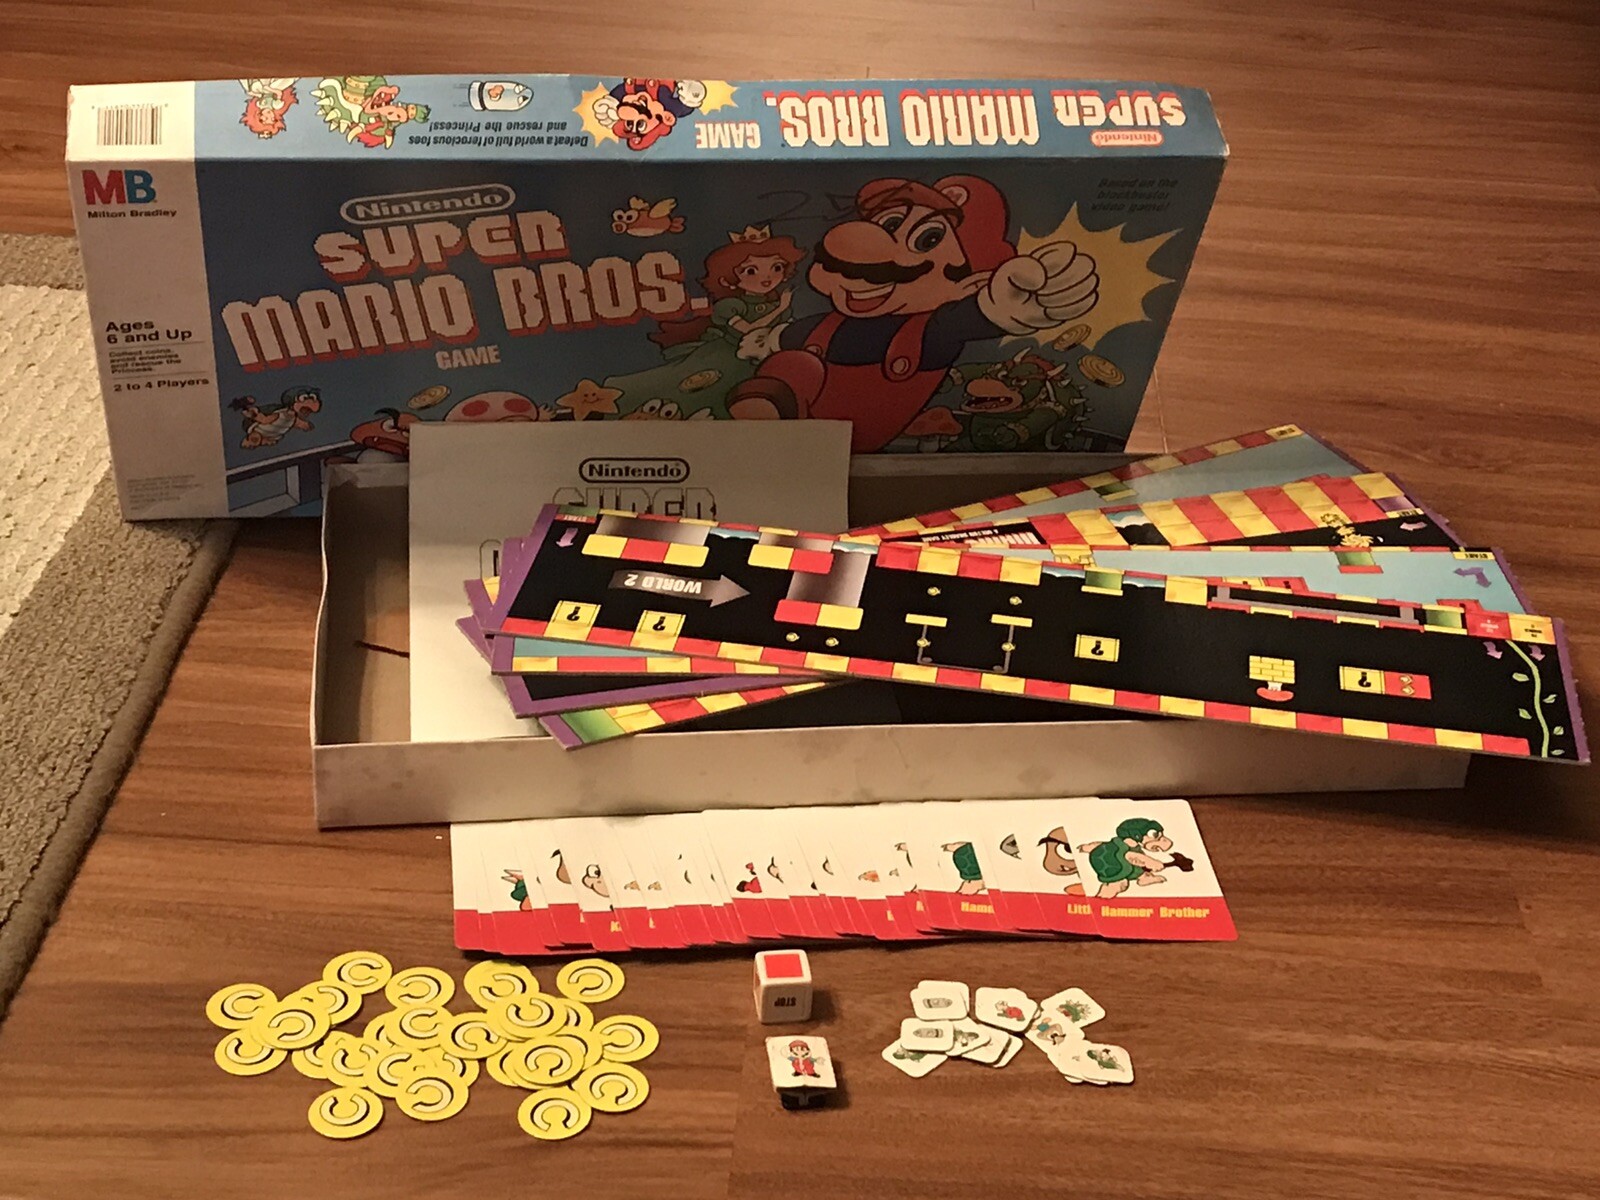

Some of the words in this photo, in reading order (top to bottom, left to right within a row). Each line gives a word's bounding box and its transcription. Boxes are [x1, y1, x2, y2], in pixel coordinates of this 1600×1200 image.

[1050, 89, 1186, 126] SUPER
[762, 89, 889, 147] BROS.
[899, 88, 1040, 146] MARIO
[429, 121, 480, 132] Princess!
[485, 121, 502, 132] the
[506, 121, 543, 132] rescue
[546, 121, 567, 132] and
[408, 135, 431, 147] foes
[433, 135, 482, 147] ferocious
[482, 135, 495, 147] of
[495, 135, 513, 147] full
[514, 135, 545, 147] world
[554, 136, 588, 147] Defeat
[694, 120, 761, 149] GAME
[1095, 132, 1158, 144] Nintendo
[81, 169, 157, 205] MB
[355, 192, 503, 219] Nintendo
[88, 210, 126, 219] Milton
[130, 209, 177, 219] Bradley
[313, 210, 569, 281] SUPER
[221, 273, 479, 373] MARIO
[493, 250, 713, 337] BROS.
[105, 320, 155, 333] Ages
[107, 334, 118, 345] 6
[125, 331, 159, 342] and
[166, 329, 193, 342] Up
[436, 345, 501, 370] GAME
[114, 384, 122, 392] 2
[126, 383, 141, 391] to
[157, 378, 210, 388] Players
[588, 463, 682, 477] Nintendo
[624, 573, 639, 587] 2
[641, 576, 702, 595] WORLD
[1101, 905, 1154, 918] Hammer
[1159, 906, 1210, 919] Brother
[774, 996, 797, 1007] STOP
